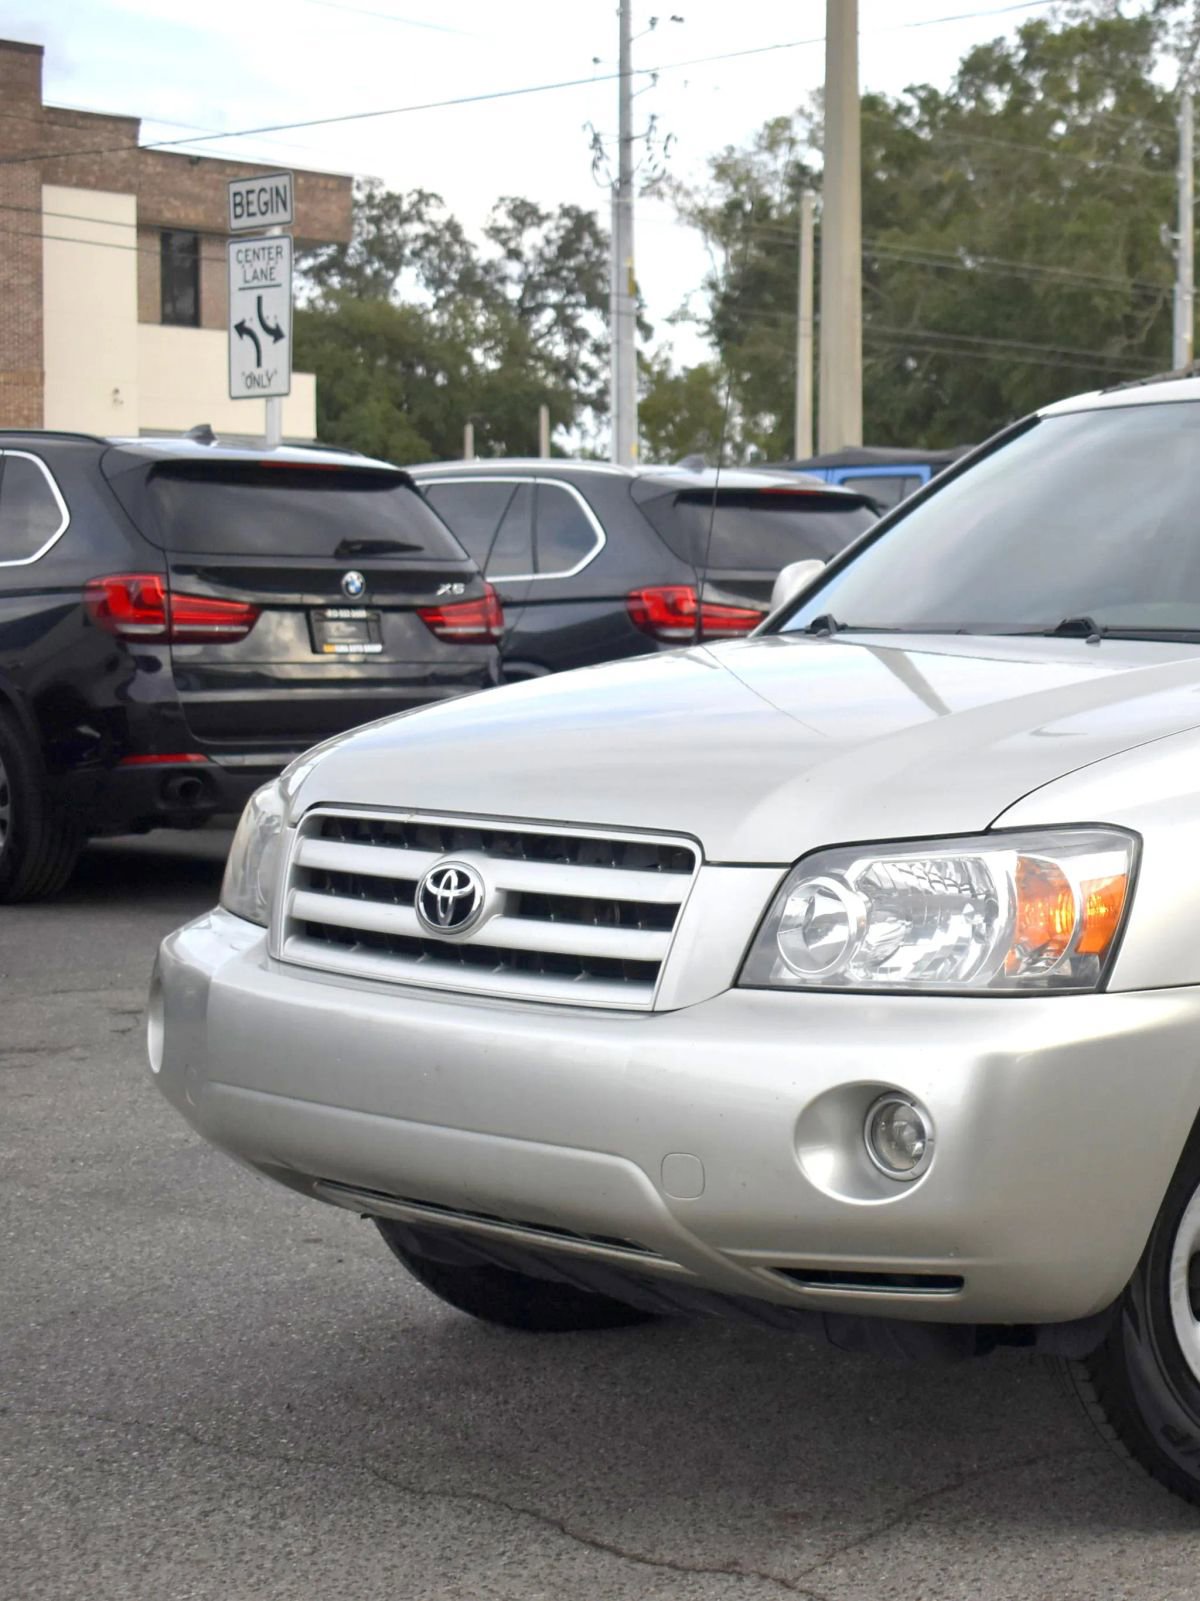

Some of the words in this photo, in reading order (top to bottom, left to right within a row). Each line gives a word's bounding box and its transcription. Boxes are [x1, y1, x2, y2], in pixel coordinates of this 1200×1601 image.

[232, 184, 288, 219] BEGIN
[236, 244, 283, 265] CENTER
[242, 266, 276, 284] LANE
[245, 373, 273, 390] ONLY
